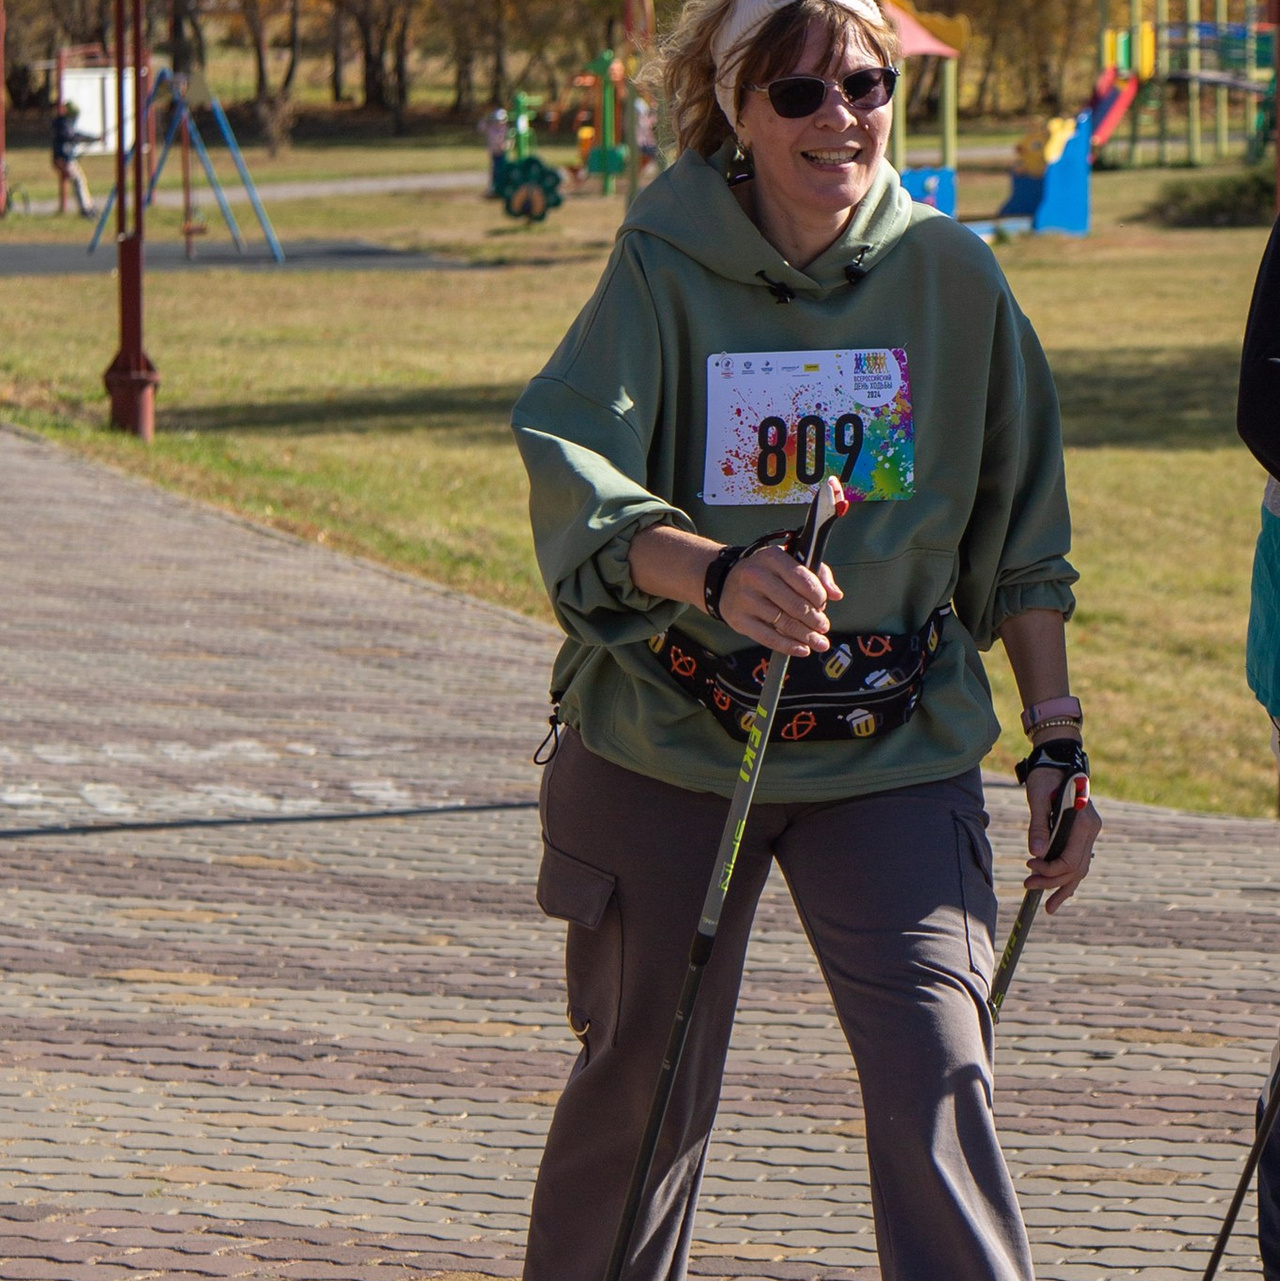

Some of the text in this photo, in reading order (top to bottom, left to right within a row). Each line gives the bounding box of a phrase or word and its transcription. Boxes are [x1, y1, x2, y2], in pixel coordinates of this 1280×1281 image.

[853, 381, 893, 390] ДЕНЬ ХОДЬБЫ
[867, 390, 881, 398] 2024
[757, 413, 864, 486] 809
[739, 704, 768, 783] LEKI
